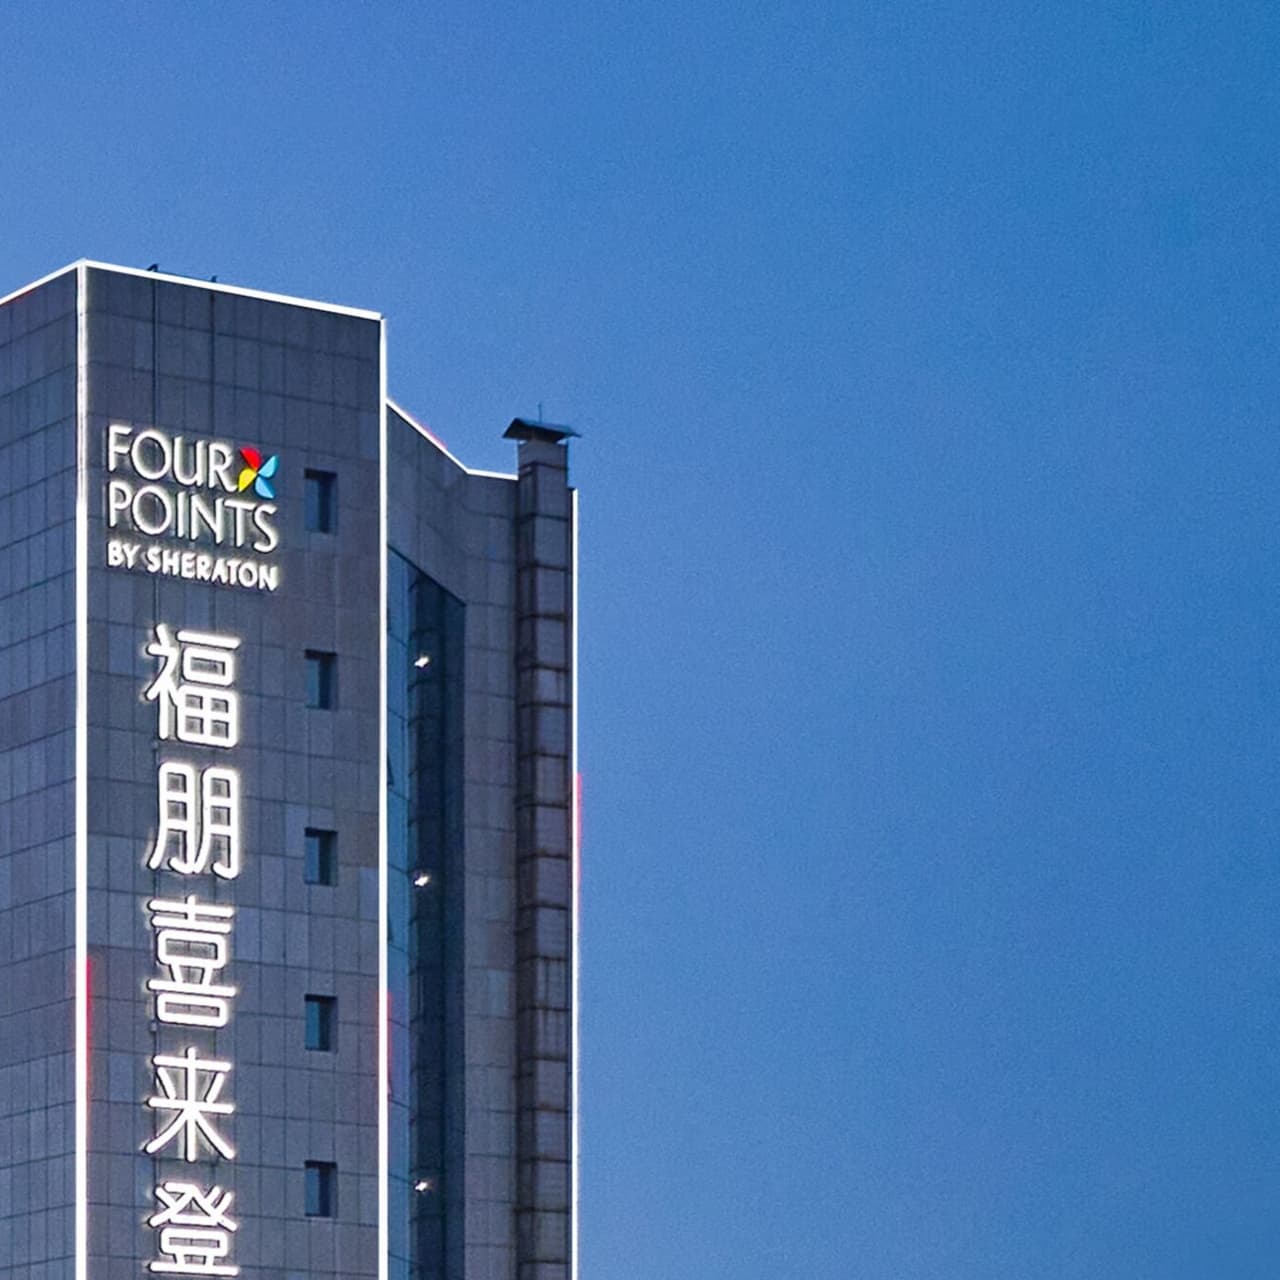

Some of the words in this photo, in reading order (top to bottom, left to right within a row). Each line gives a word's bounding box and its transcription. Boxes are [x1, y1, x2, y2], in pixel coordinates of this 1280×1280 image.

[107, 425, 238, 493] FOUR
[108, 480, 279, 553] POINTS
[108, 541, 140, 568] BY
[147, 546, 279, 592] SHERATON
